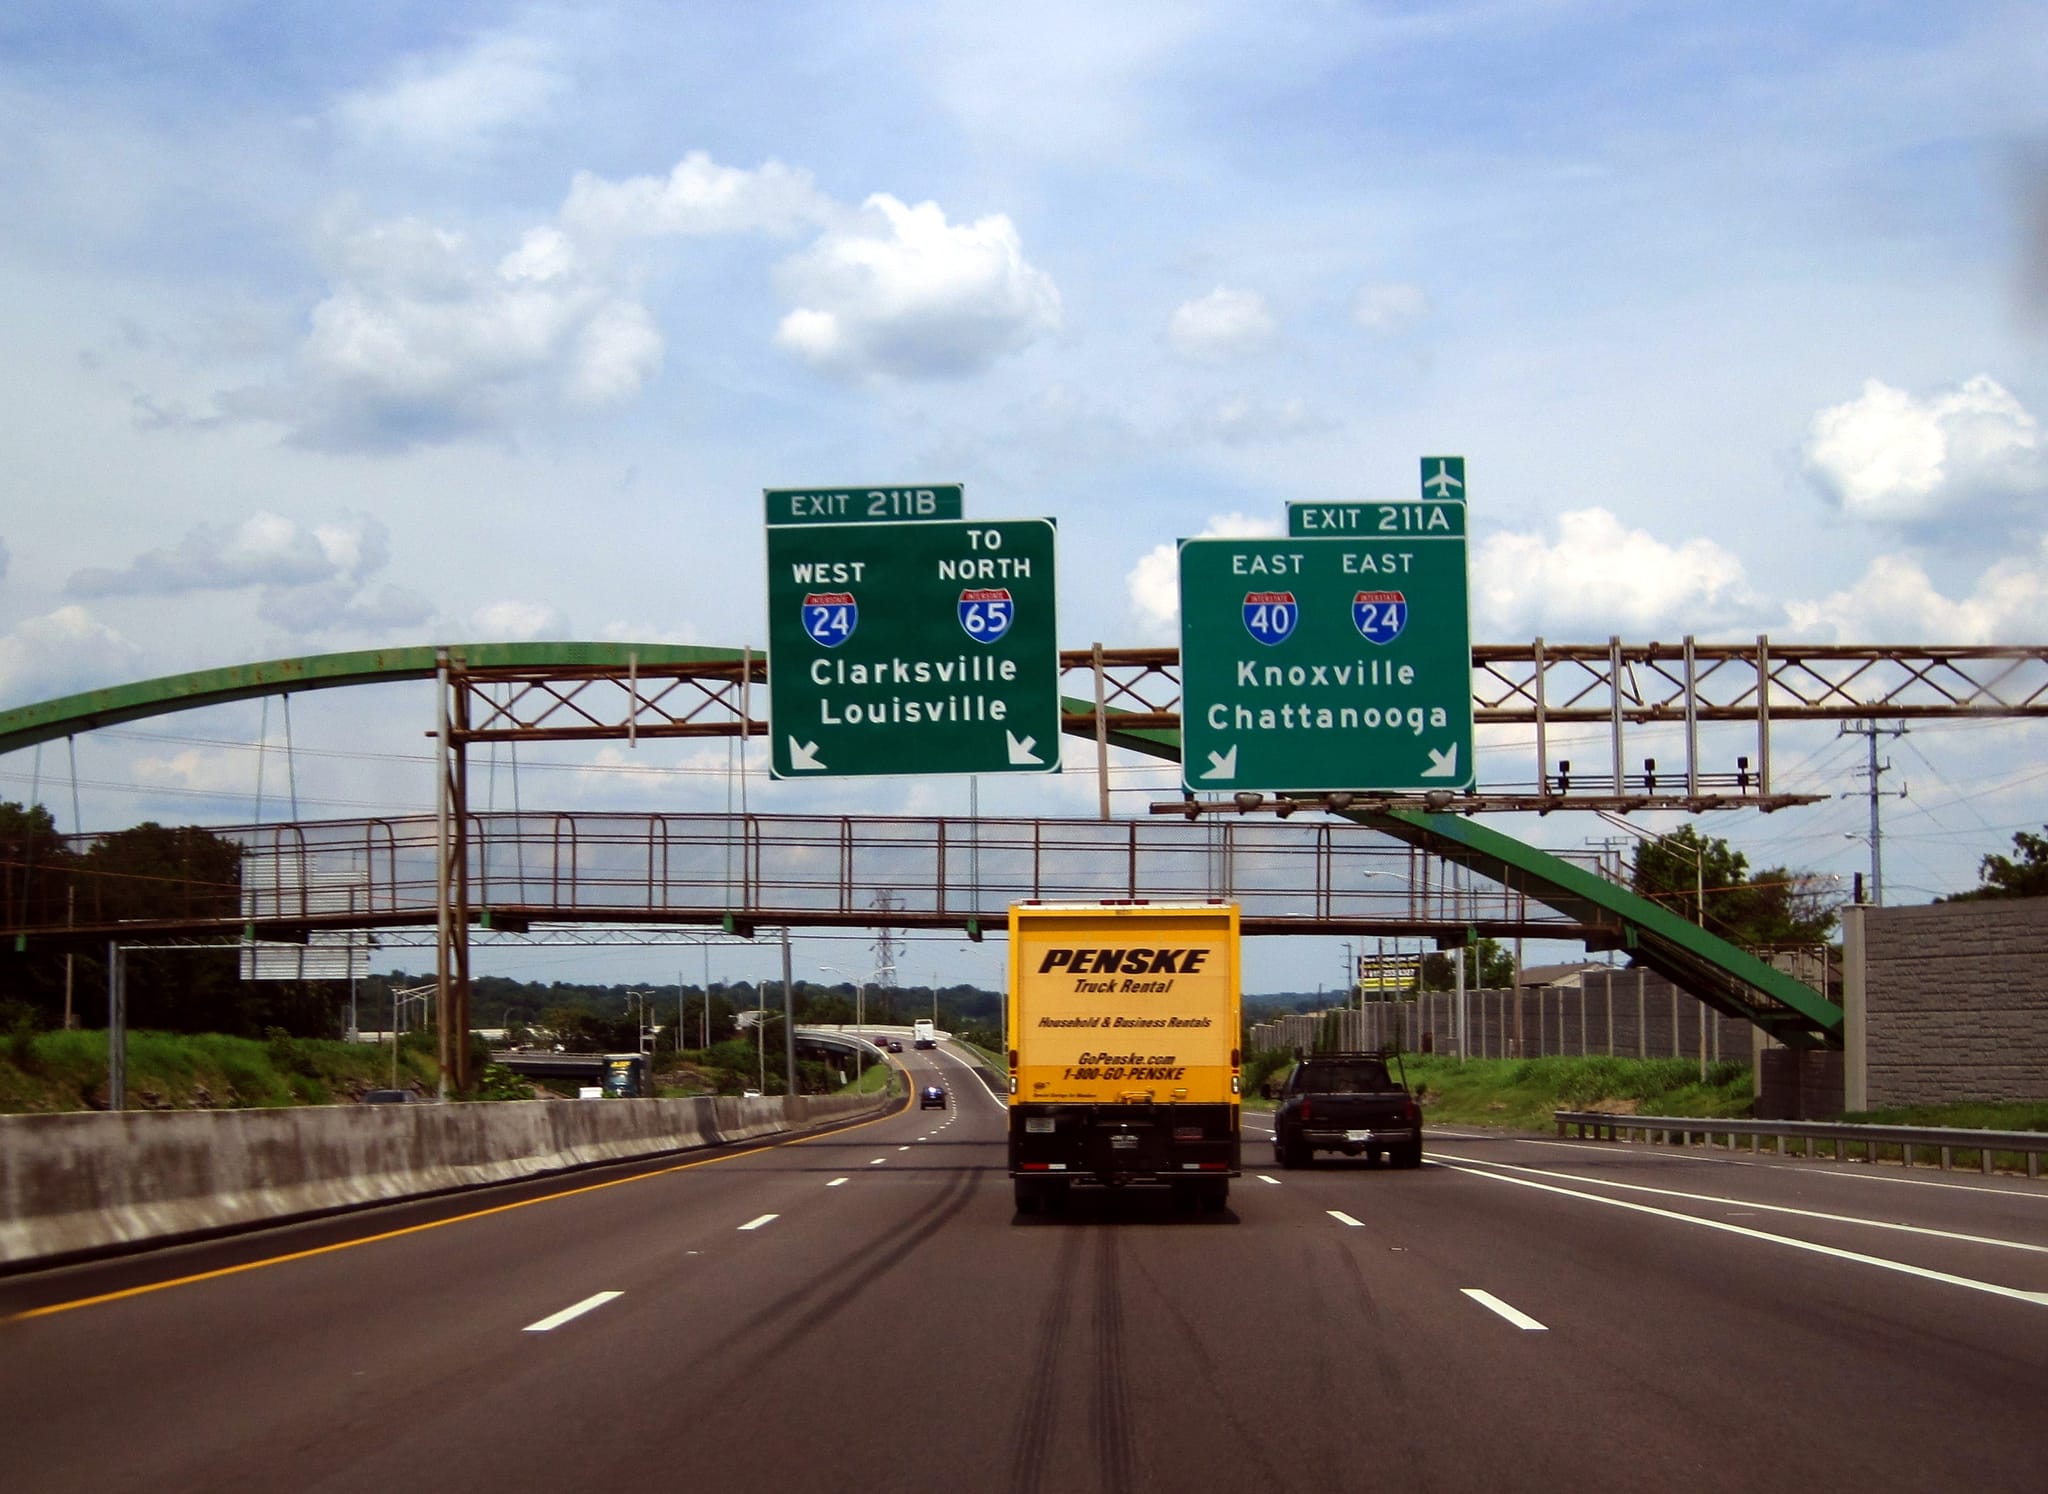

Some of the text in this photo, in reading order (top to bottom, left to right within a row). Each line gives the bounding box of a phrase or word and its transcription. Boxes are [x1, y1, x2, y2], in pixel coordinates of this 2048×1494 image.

[791, 490, 937, 516] EXIT 211B
[1302, 506, 1450, 530] EXIT 211A
[967, 530, 1001, 550] TO
[792, 562, 865, 584] WEST
[938, 558, 1031, 580] NORTH
[1232, 554, 1304, 574] EAST
[1342, 553, 1414, 574] EAST
[812, 606, 849, 636] 24
[965, 602, 1008, 633] 65
[1250, 605, 1290, 634] 40
[1361, 604, 1400, 634] 24
[810, 655, 1018, 685] Clarksville
[1237, 660, 1415, 687] Knoxville
[821, 695, 1008, 725] Louisville
[1207, 703, 1448, 736] Chattanooga
[1038, 949, 1211, 974] PENSKE
[1074, 979, 1174, 993] Truck Rental
[1038, 1017, 1212, 1028] Household & Business Rentals
[1078, 1052, 1176, 1065] GoPenske.com
[1063, 1067, 1186, 1080] 1-800-GO-PENSKE
